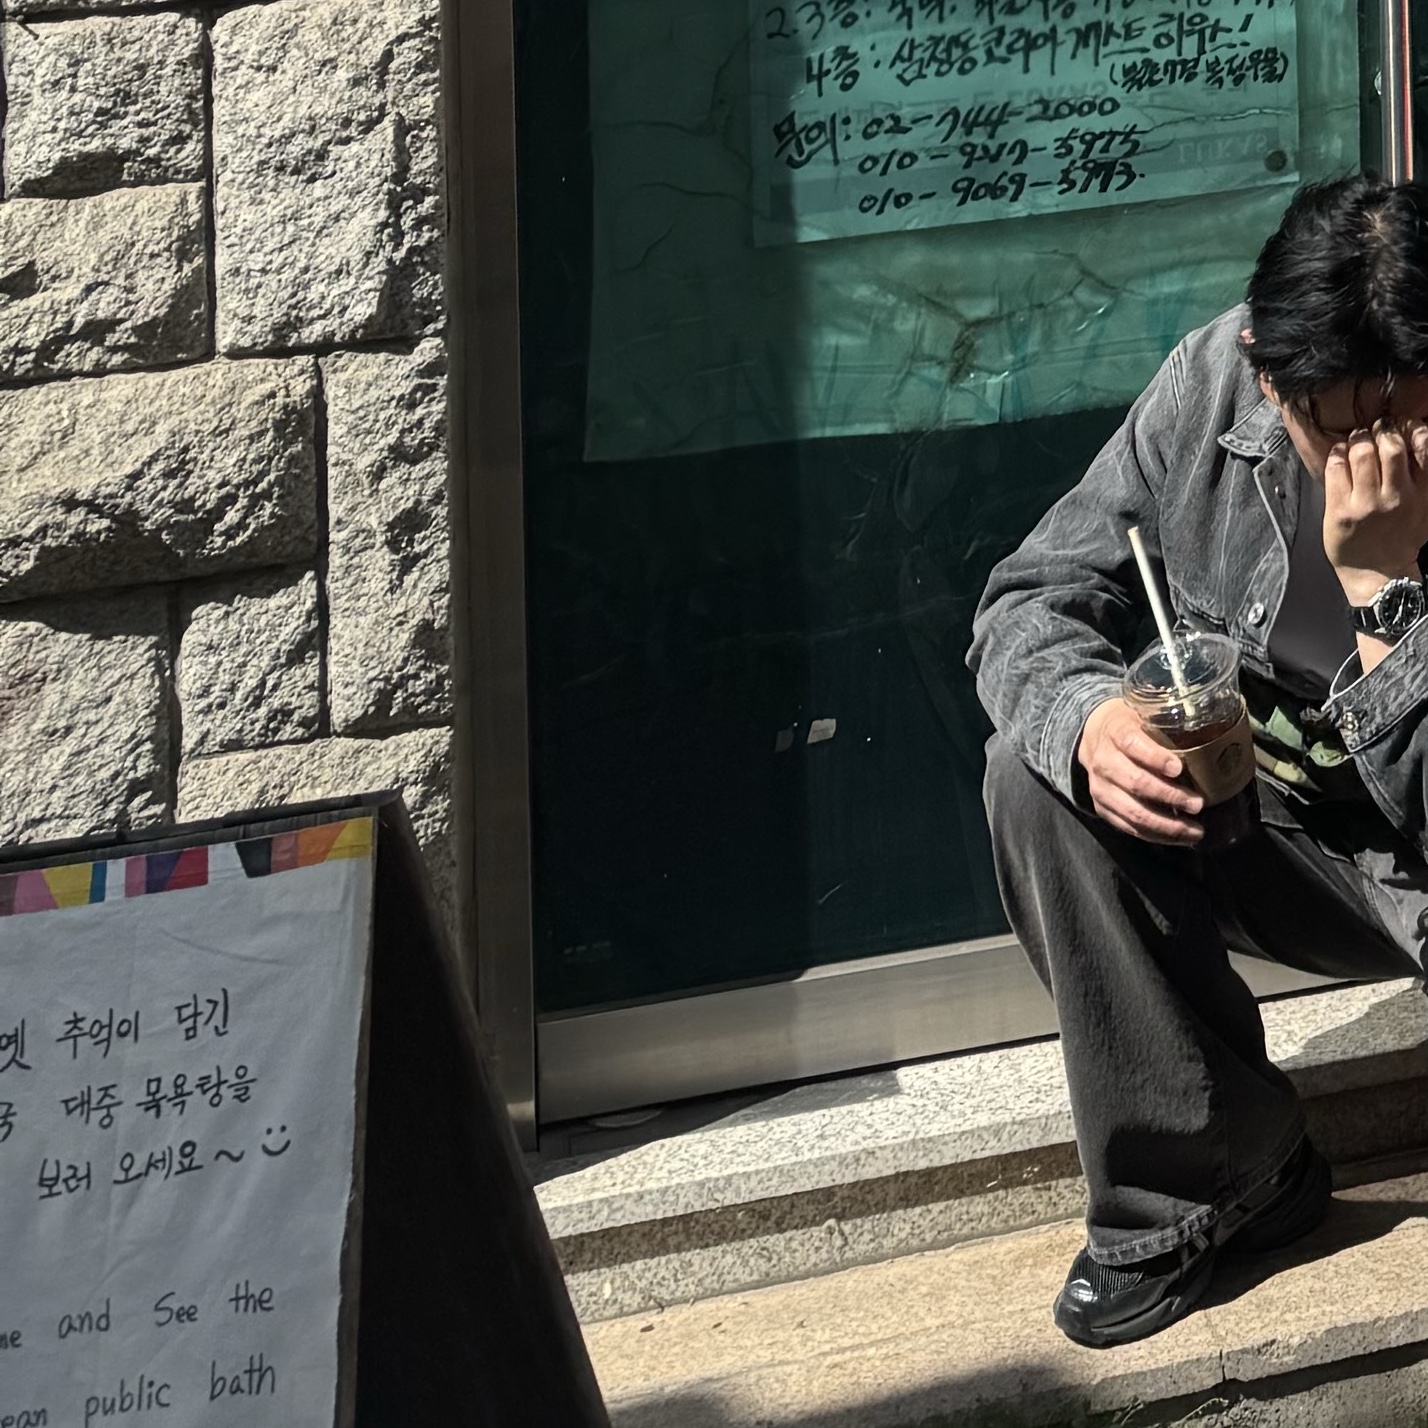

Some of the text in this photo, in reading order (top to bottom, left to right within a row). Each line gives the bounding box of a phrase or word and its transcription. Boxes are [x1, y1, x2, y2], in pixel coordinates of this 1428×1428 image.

[56, 1008, 140, 1059] 추억이
[175, 988, 229, 1041] 담긴
[61, 1065, 257, 1129] 대중 목욕탕을
[38, 1158, 91, 1200] 보러
[58, 1298, 111, 1339] and
[229, 1280, 274, 1314] the
[85, 1353, 275, 1428] public bath
